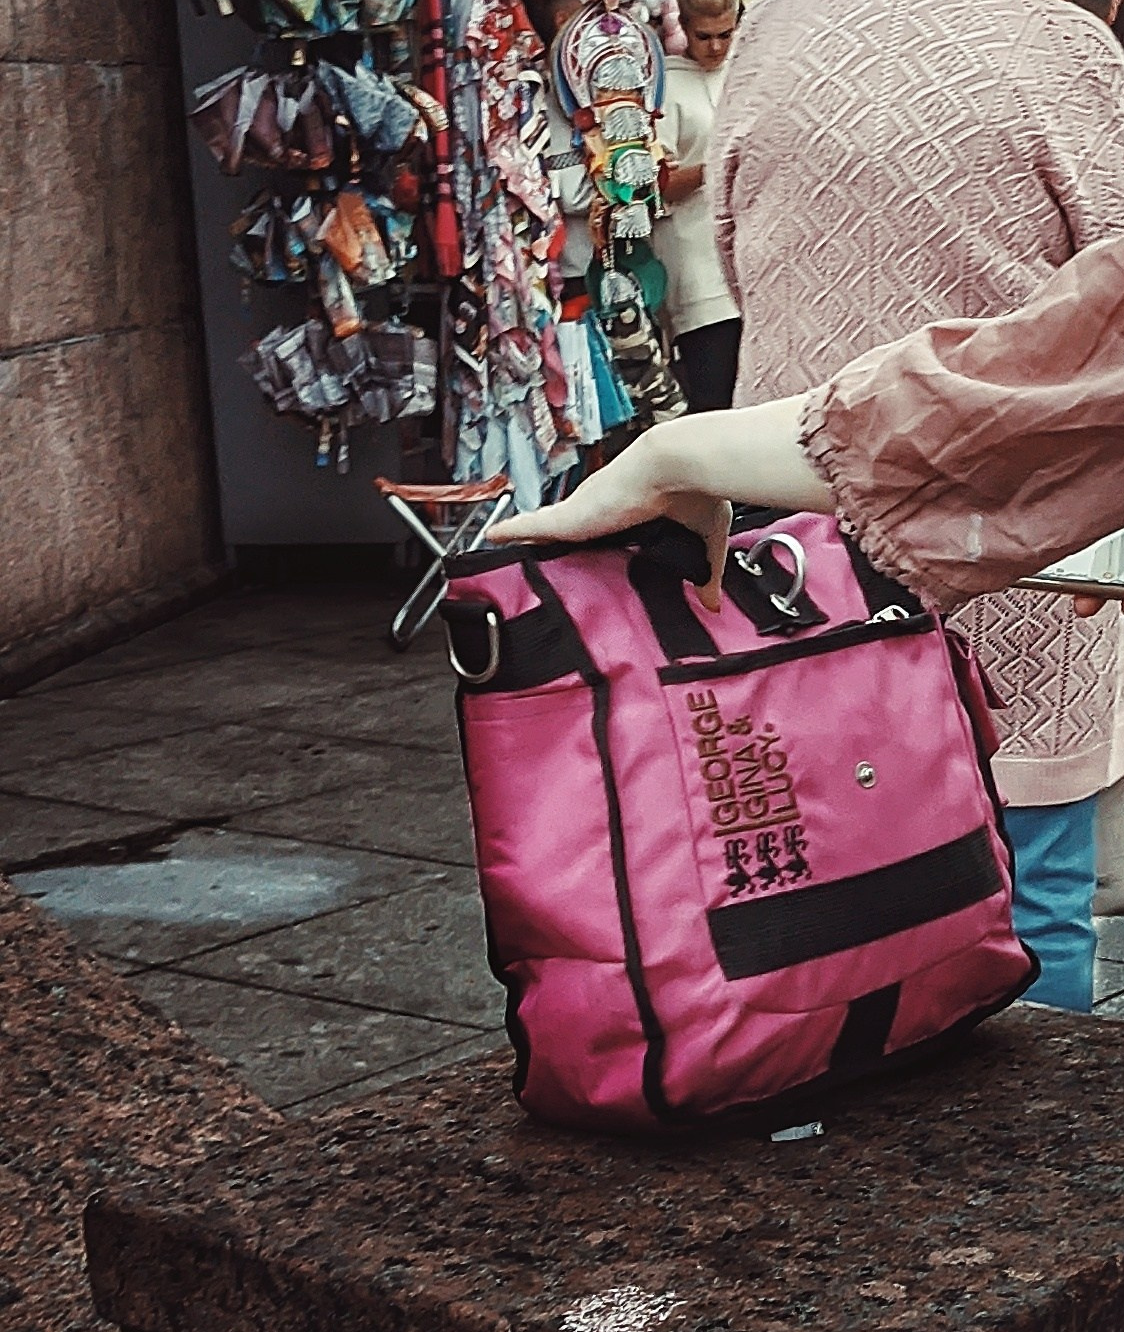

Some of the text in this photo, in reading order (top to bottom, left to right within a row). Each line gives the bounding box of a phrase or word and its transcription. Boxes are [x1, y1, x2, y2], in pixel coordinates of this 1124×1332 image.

[687, 689, 740, 826] GEORGE
[727, 714, 770, 819] GINA &
